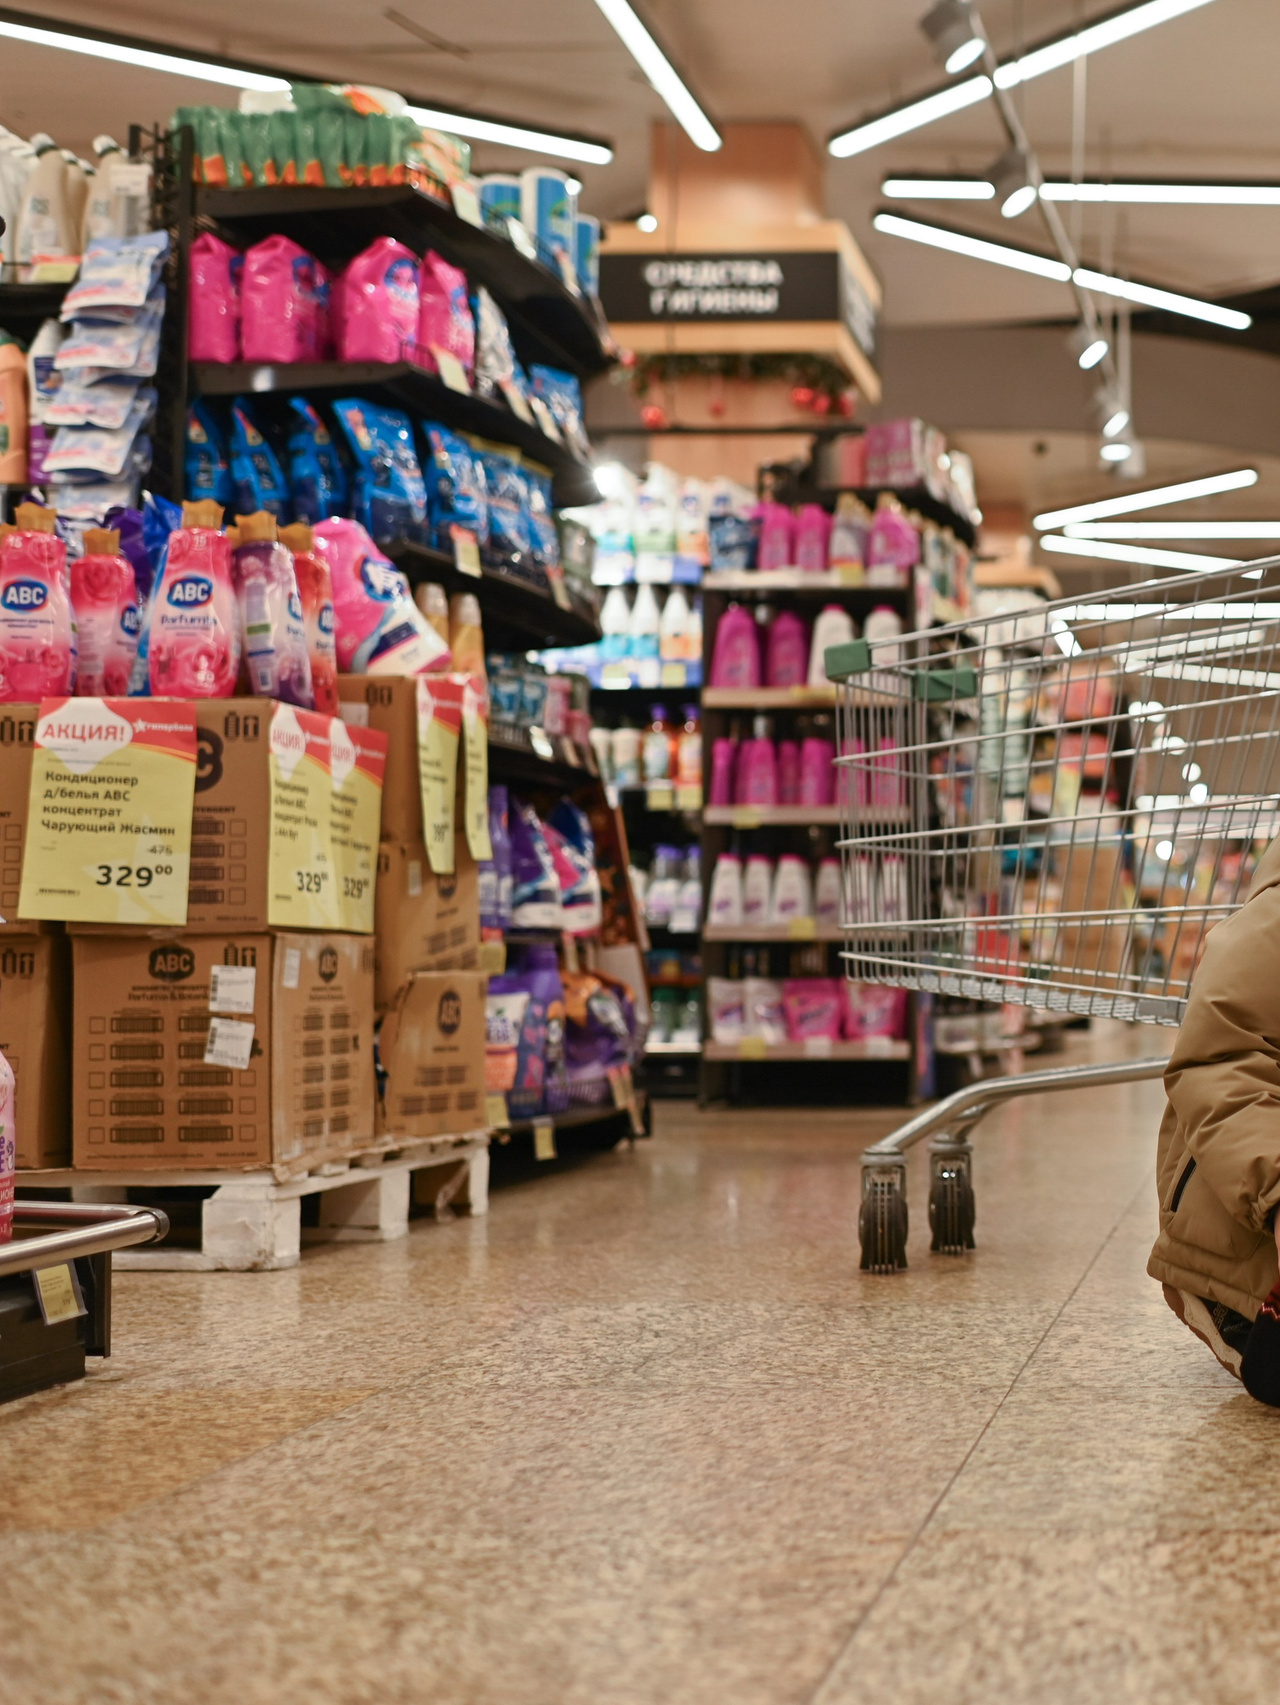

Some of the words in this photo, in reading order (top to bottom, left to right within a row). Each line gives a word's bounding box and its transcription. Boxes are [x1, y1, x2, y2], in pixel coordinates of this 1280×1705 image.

[6, 586, 44, 604] ABC
[171, 582, 210, 602] ABC
[42, 723, 125, 742] АКЦИЯ!
[45, 771, 139, 788] Кондиционер
[43, 788, 99, 800] д/белья
[43, 805, 122, 817] концентрат
[41, 819, 116, 834] Чарующий
[120, 823, 176, 836] Жасмин
[96, 865, 153, 888] 329
[297, 871, 322, 894] 329
[155, 953, 191, 973] ABC
[321, 955, 337, 972] ABC
